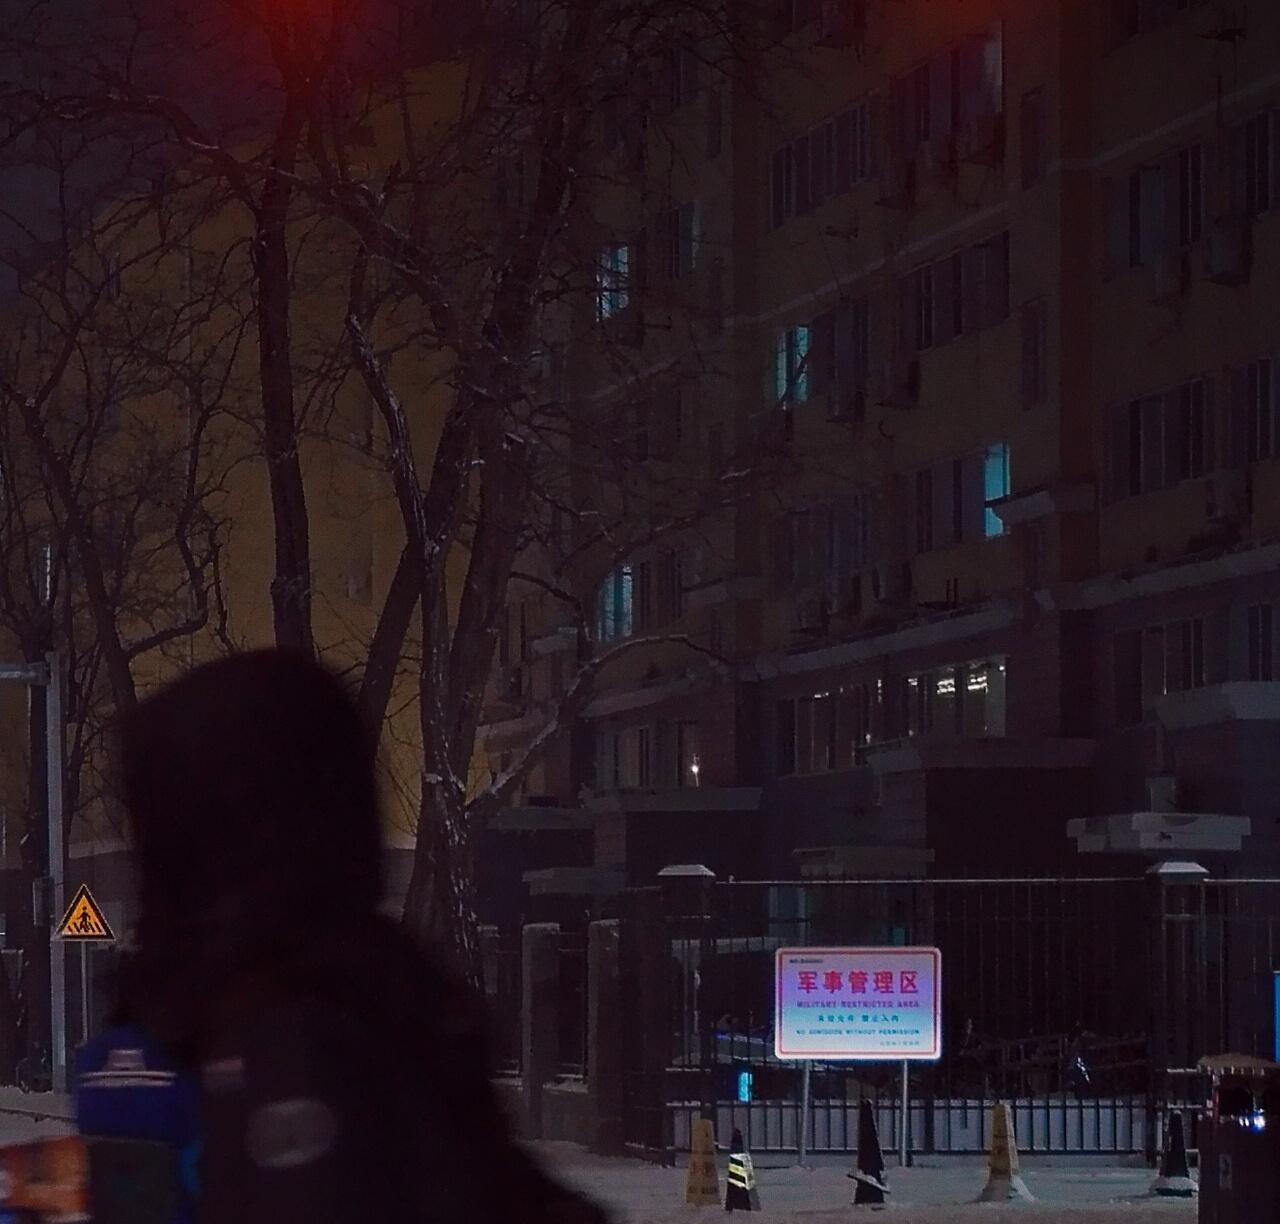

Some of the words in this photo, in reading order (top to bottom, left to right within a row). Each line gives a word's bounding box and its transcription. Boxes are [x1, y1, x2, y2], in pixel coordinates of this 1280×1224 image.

[797, 970, 919, 994] 军事管理区
[796, 1000, 837, 1008] MILITARY
[841, 1000, 893, 1008] RESTRICTED
[897, 1000, 920, 1008] AREA
